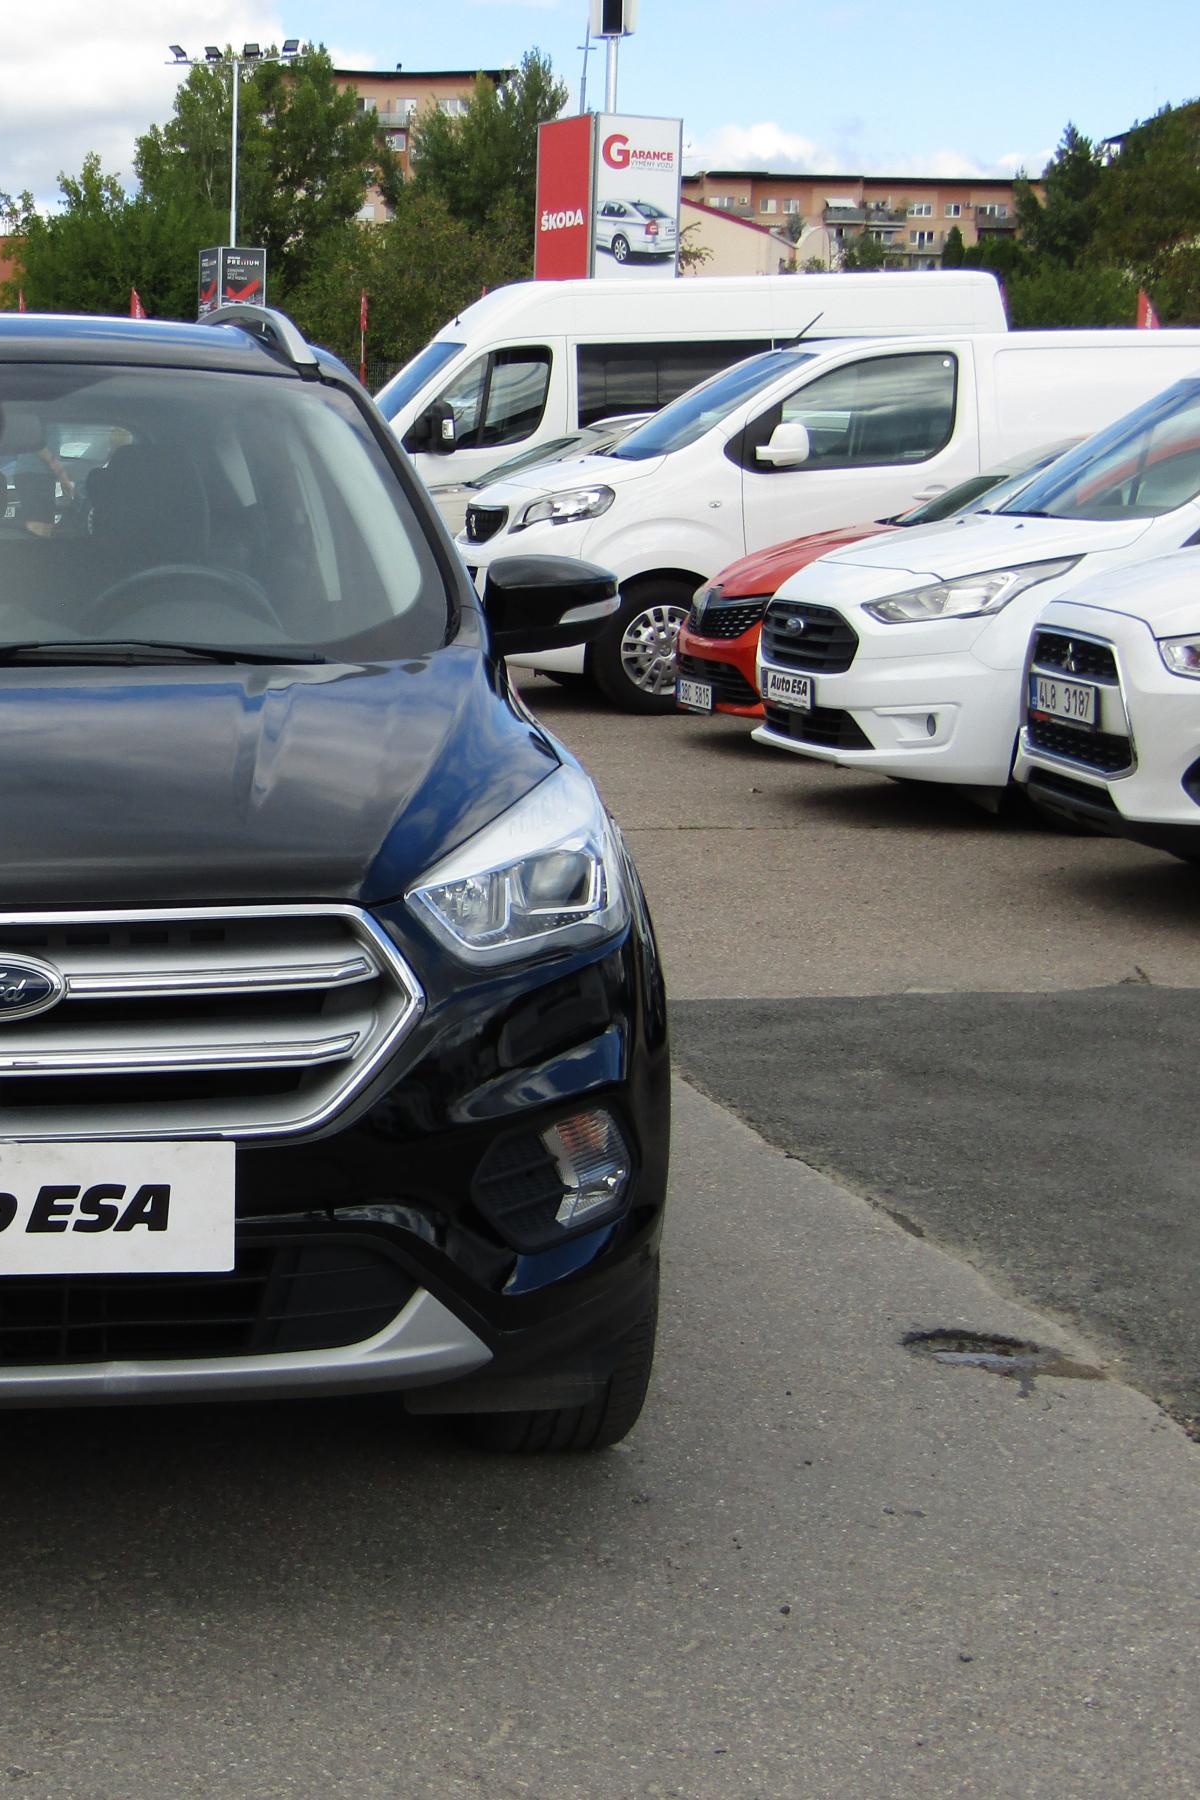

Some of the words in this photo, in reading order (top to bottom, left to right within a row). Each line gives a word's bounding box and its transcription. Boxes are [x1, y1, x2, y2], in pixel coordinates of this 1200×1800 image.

[602, 134, 673, 170] GARANCE
[541, 209, 584, 231] ŠKODA
[770, 675, 791, 693] Auto
[791, 679, 808, 697] ESA
[1039, 682, 1056, 710] 4L8
[1064, 687, 1090, 718] 3187
[25, 1183, 171, 1233] ESA
